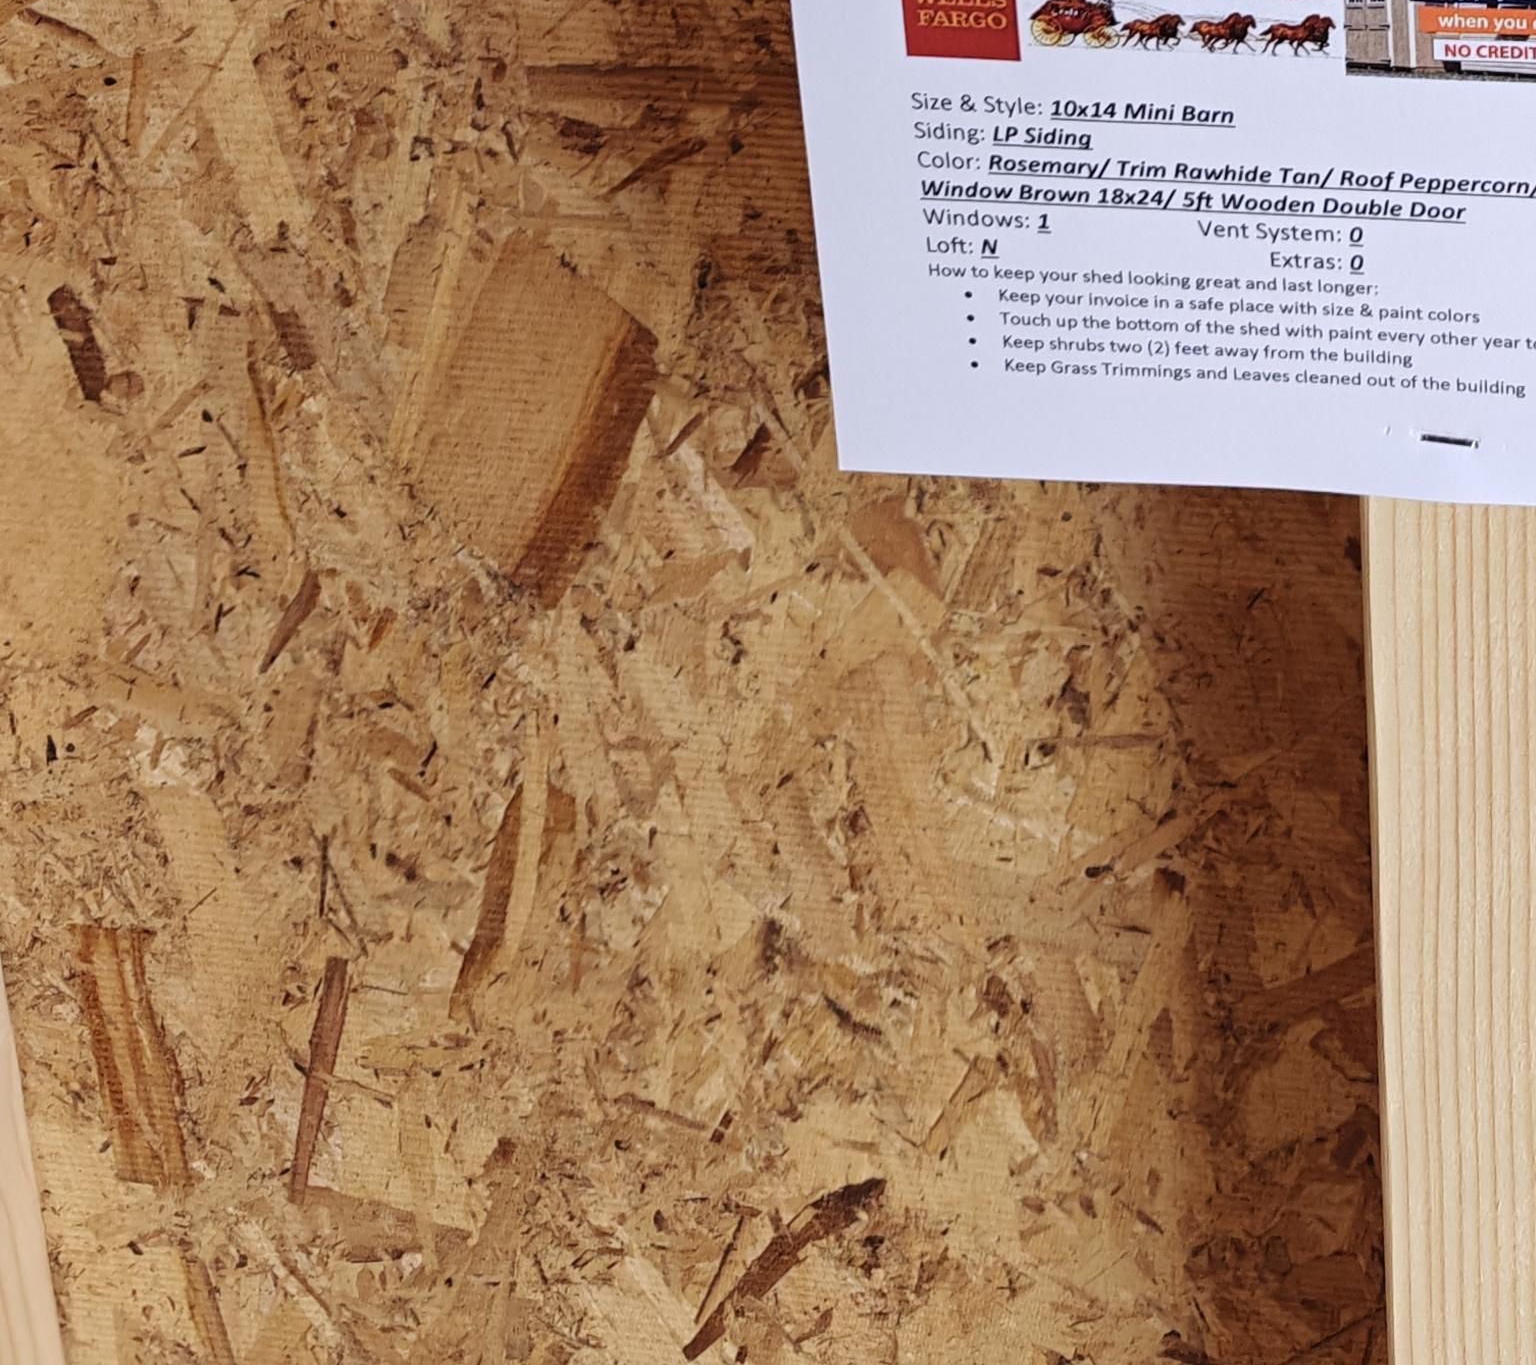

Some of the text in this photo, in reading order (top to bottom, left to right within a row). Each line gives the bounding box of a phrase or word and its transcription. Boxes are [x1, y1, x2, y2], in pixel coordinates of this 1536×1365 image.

[917, 9, 1008, 30] FARGO
[1438, 13, 1487, 30] when
[1494, 17, 1529, 34] you
[1444, 43, 1472, 59] NO
[911, 92, 1236, 128] Size & Style: 10x14 Mini Barn
[914, 122, 1093, 150] Siding: LP Siding
[918, 151, 980, 169] Color:
[988, 155, 1114, 180] Rosemary/
[1115, 160, 1169, 182] Trim
[1172, 163, 1274, 187] Rawhide
[1276, 168, 1337, 190] Tan/
[1337, 170, 1398, 192] Roof
[920, 180, 1466, 224] Window Brown 18x24/ 5ft Wooden Double Door
[923, 208, 1051, 234] Windows: 1
[1198, 220, 1249, 238] Vent
[1256, 223, 1341, 244] System:
[927, 237, 999, 259] Loft: N
[1270, 252, 1342, 270] Extras:
[929, 264, 1378, 297] How to keep your shed looking great and last longer:
[999, 289, 1480, 323] Keep your invoice in a safe place with size & paint colors
[1000, 312, 1051, 327] Touch
[1057, 318, 1077, 331] up
[1082, 315, 1110, 329] the
[1116, 317, 1178, 332] bottom
[1185, 320, 1201, 333] of
[1206, 320, 1234, 334] the
[1240, 322, 1280, 336] shed
[1285, 325, 1323, 338] with
[1329, 327, 1372, 341] paint
[1378, 332, 1425, 346] every
[1431, 332, 1477, 346] other
[1483, 338, 1520, 350] year
[1003, 335, 1412, 368] Keep shrubs two (2) feet away from the building
